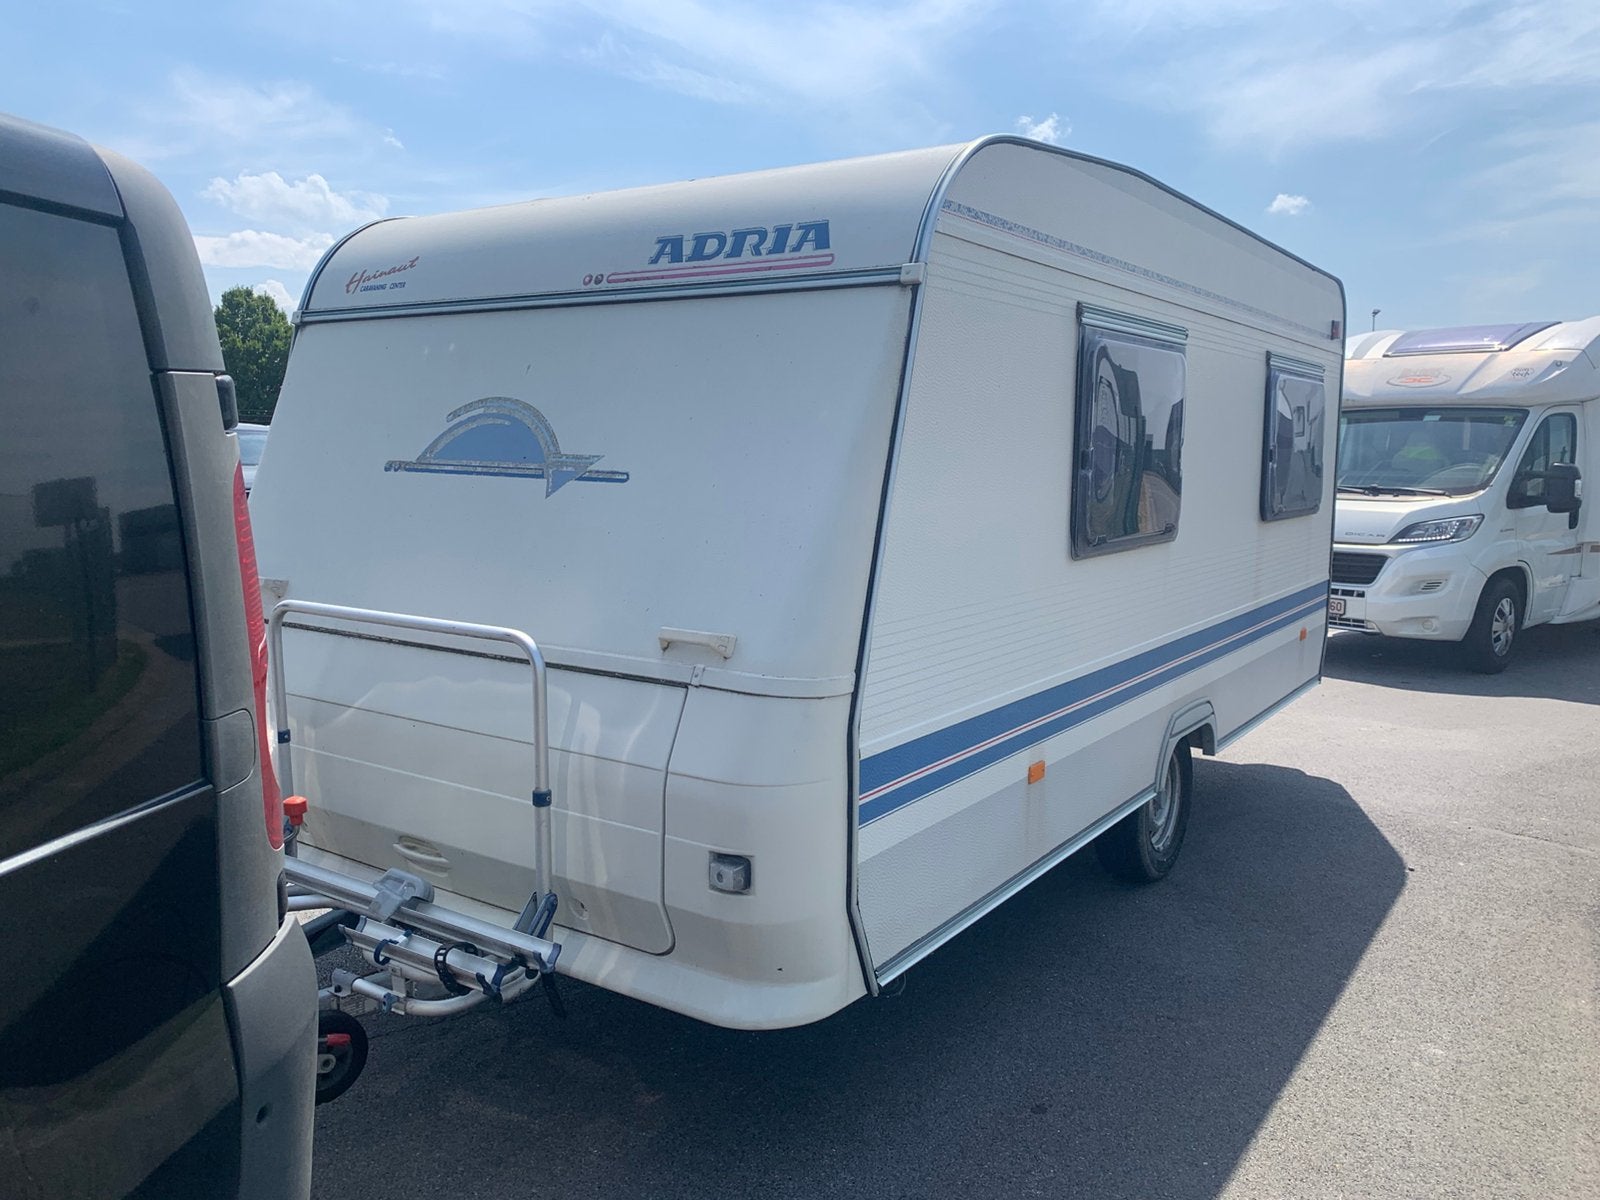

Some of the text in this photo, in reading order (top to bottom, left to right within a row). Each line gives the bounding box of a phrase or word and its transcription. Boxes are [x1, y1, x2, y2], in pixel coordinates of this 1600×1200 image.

[648, 219, 831, 265] ADRIA
[345, 255, 420, 294] Hainaut
[389, 281, 406, 290] CENTER
[1329, 600, 1343, 612] 60
